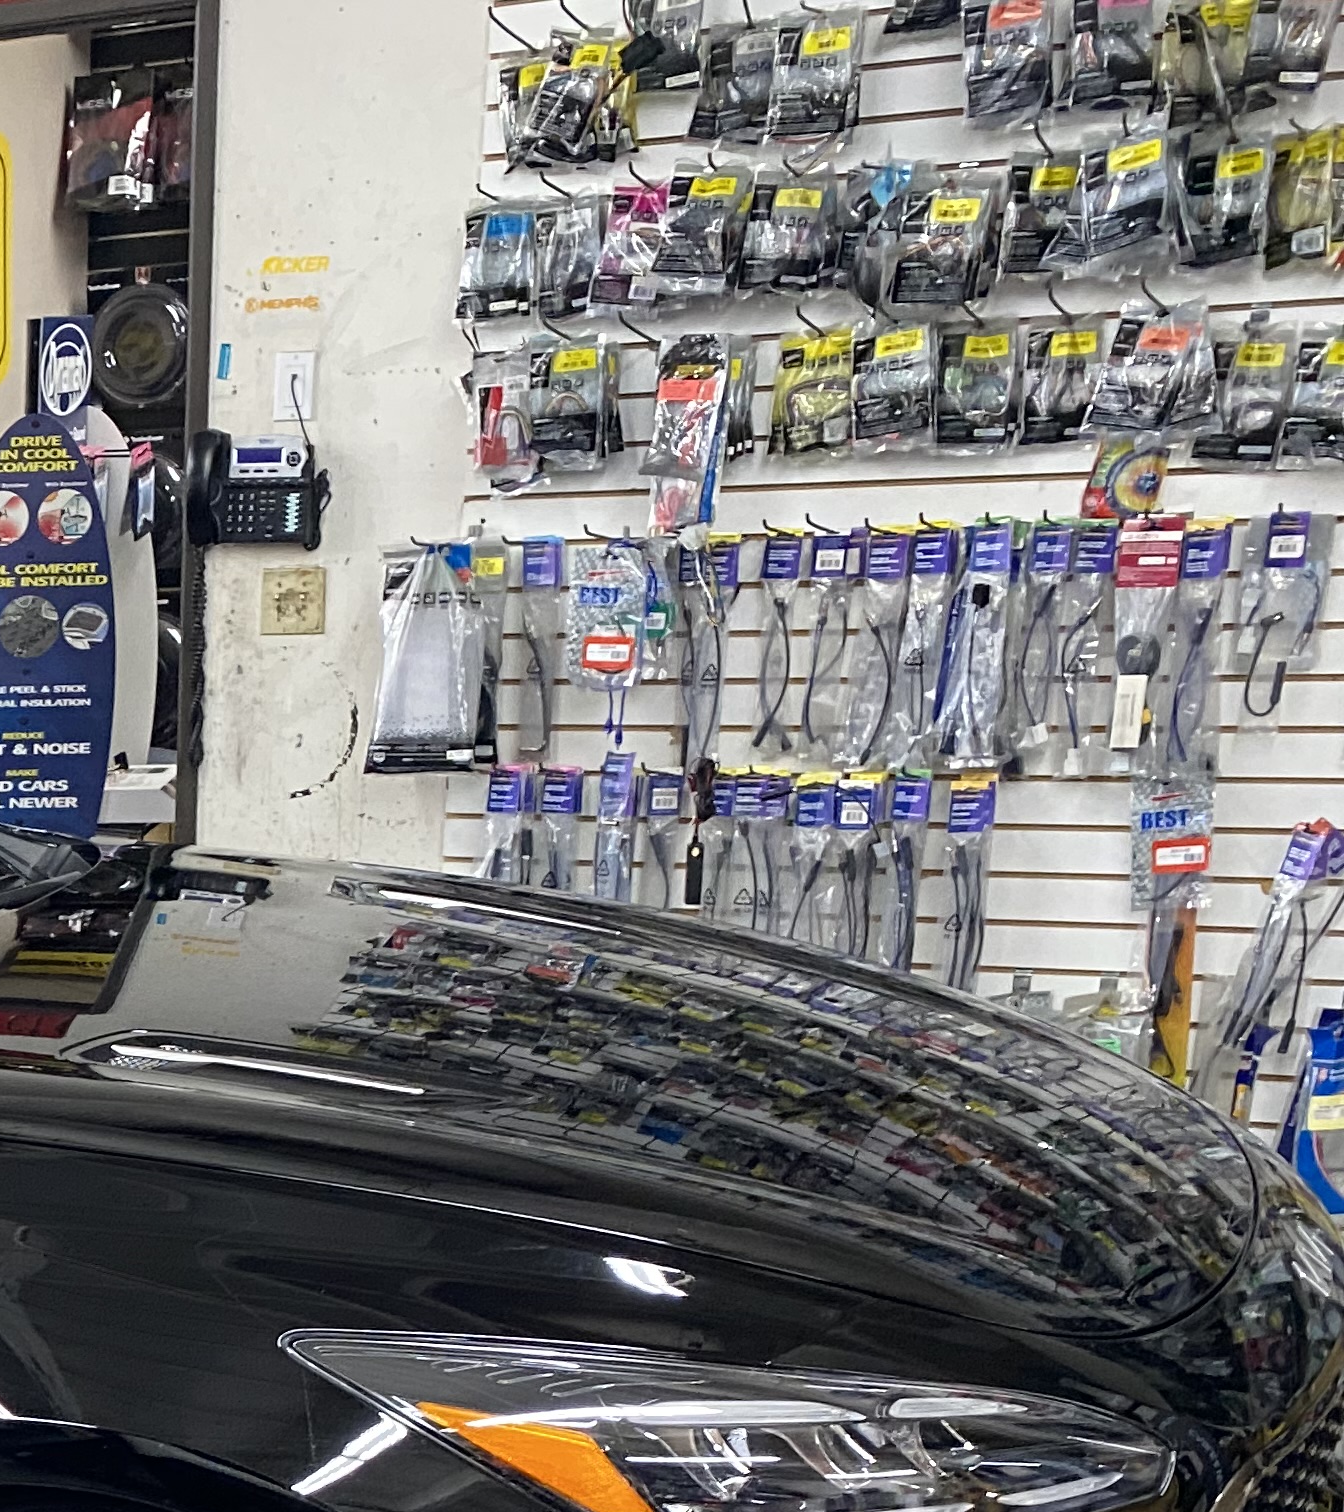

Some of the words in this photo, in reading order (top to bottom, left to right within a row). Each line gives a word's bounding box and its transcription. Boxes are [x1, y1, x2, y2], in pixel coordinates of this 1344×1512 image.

[10, 435, 62, 448] DRIVE
[0, 449, 18, 460] IN
[23, 447, 72, 459] COOL
[14, 562, 99, 575] COMFORT
[20, 575, 109, 587] INSTALLED
[9, 685, 37, 694] PEEL
[40, 685, 50, 693] &
[53, 684, 87, 692] STICK
[20, 698, 92, 708] INSULATION
[12, 743, 28, 756] &
[33, 742, 91, 755] NOISE
[18, 779, 69, 792] CARS
[9, 796, 79, 809] NEWER
[1140, 808, 1190, 830] BEST
